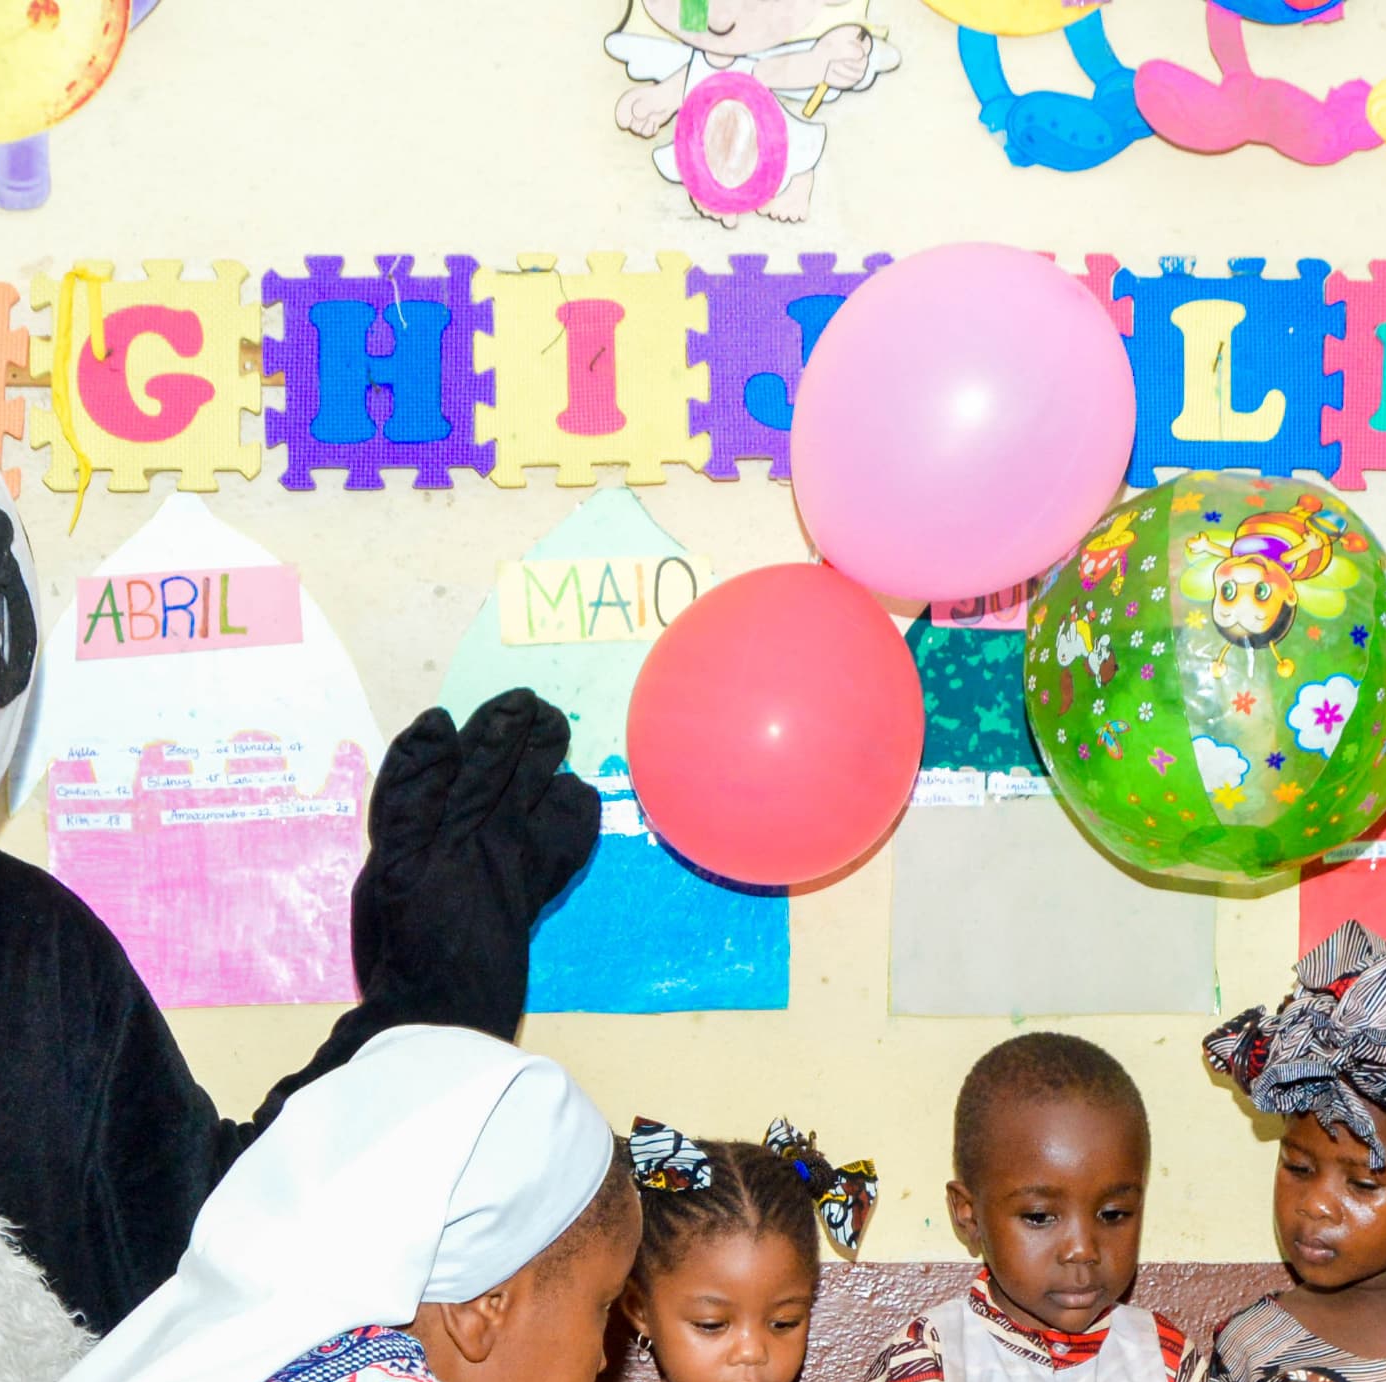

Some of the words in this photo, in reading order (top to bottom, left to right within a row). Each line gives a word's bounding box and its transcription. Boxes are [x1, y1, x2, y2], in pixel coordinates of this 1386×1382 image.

[77, 305, 215, 442] G
[309, 299, 452, 443] H
[557, 299, 626, 436] I
[1170, 299, 1286, 441] L
[83, 573, 247, 644] ABRIL
[523, 556, 697, 638] MAIO
